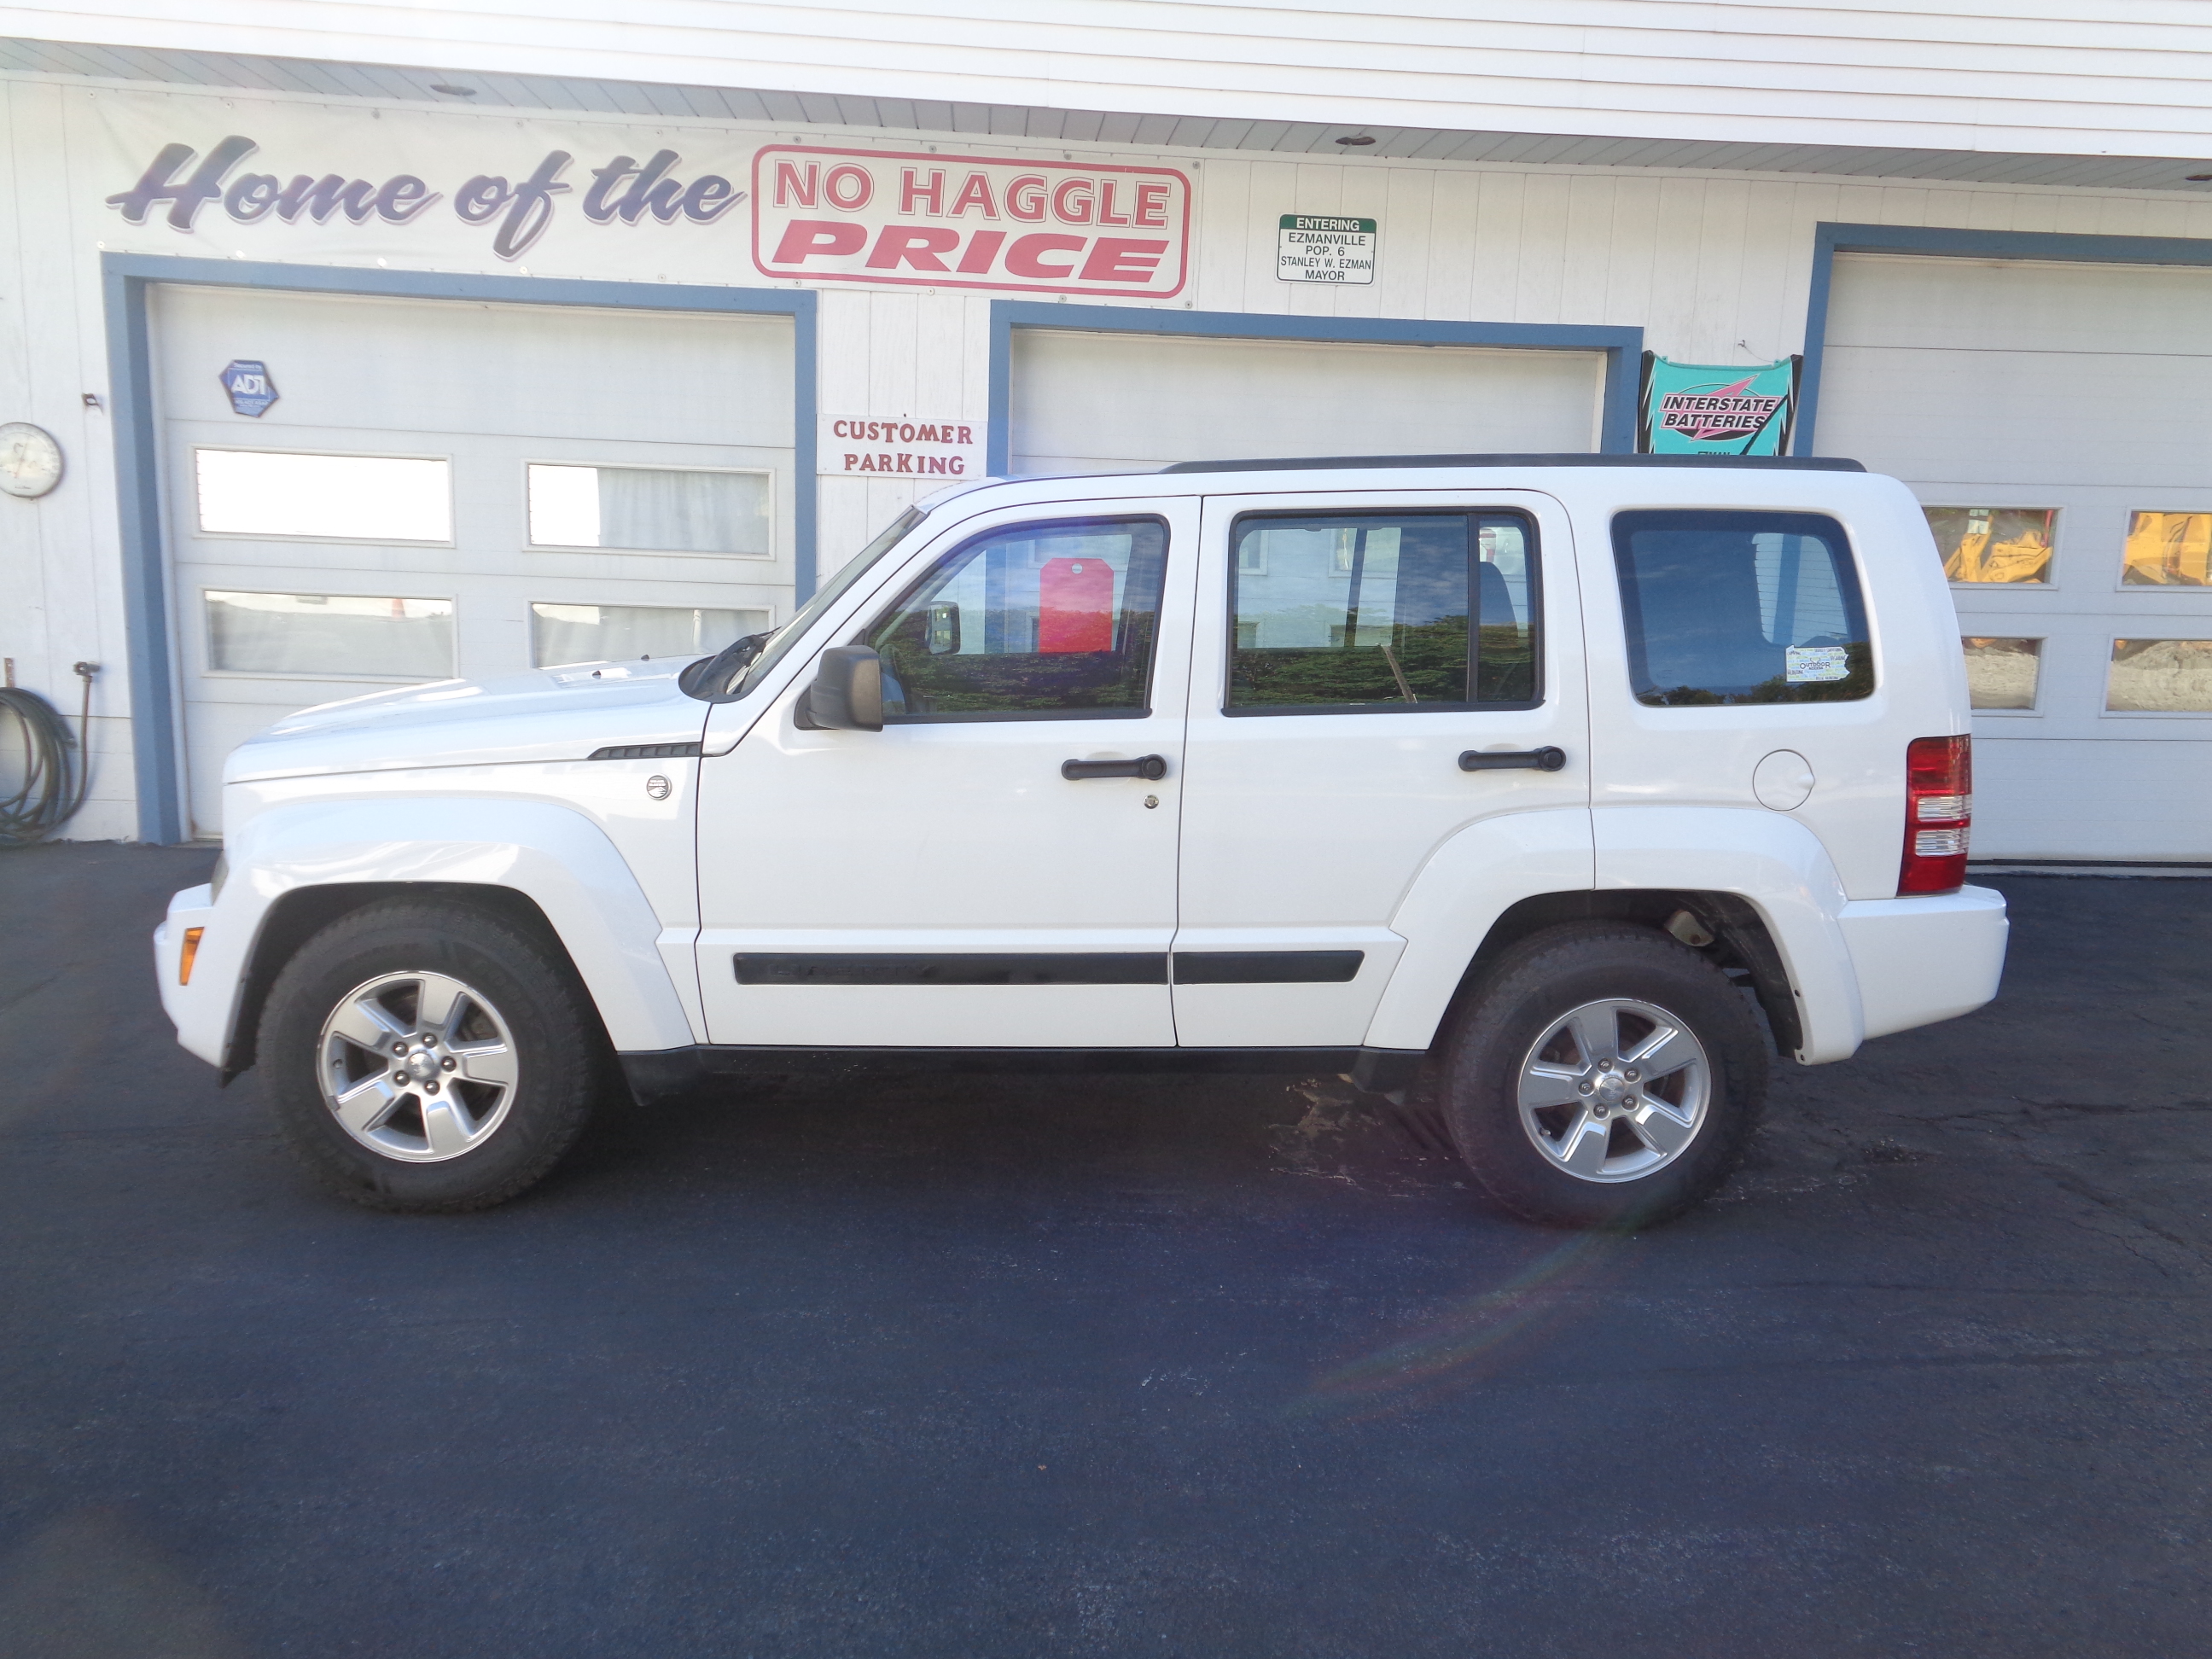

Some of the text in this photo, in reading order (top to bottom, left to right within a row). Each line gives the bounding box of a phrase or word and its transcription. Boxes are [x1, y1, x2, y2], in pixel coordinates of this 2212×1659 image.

[105, 135, 748, 262] Home of the
[773, 159, 1171, 230] NO HAGGLE
[1296, 218, 1359, 231] ENTERING
[1289, 232, 1366, 246] EZMANVILLE
[771, 219, 1170, 283] PRICE
[1306, 246, 1345, 256] POP. 6
[1281, 256, 1371, 270] STANLEY W. EZMAN
[1306, 270, 1345, 281] MAYOR
[230, 374, 266, 395] ADT
[1663, 396, 1776, 412] INTERSTATE
[1664, 413, 1766, 428] BATTERIES
[833, 420, 973, 444] CUSTOMER
[844, 453, 964, 474] PARKING
